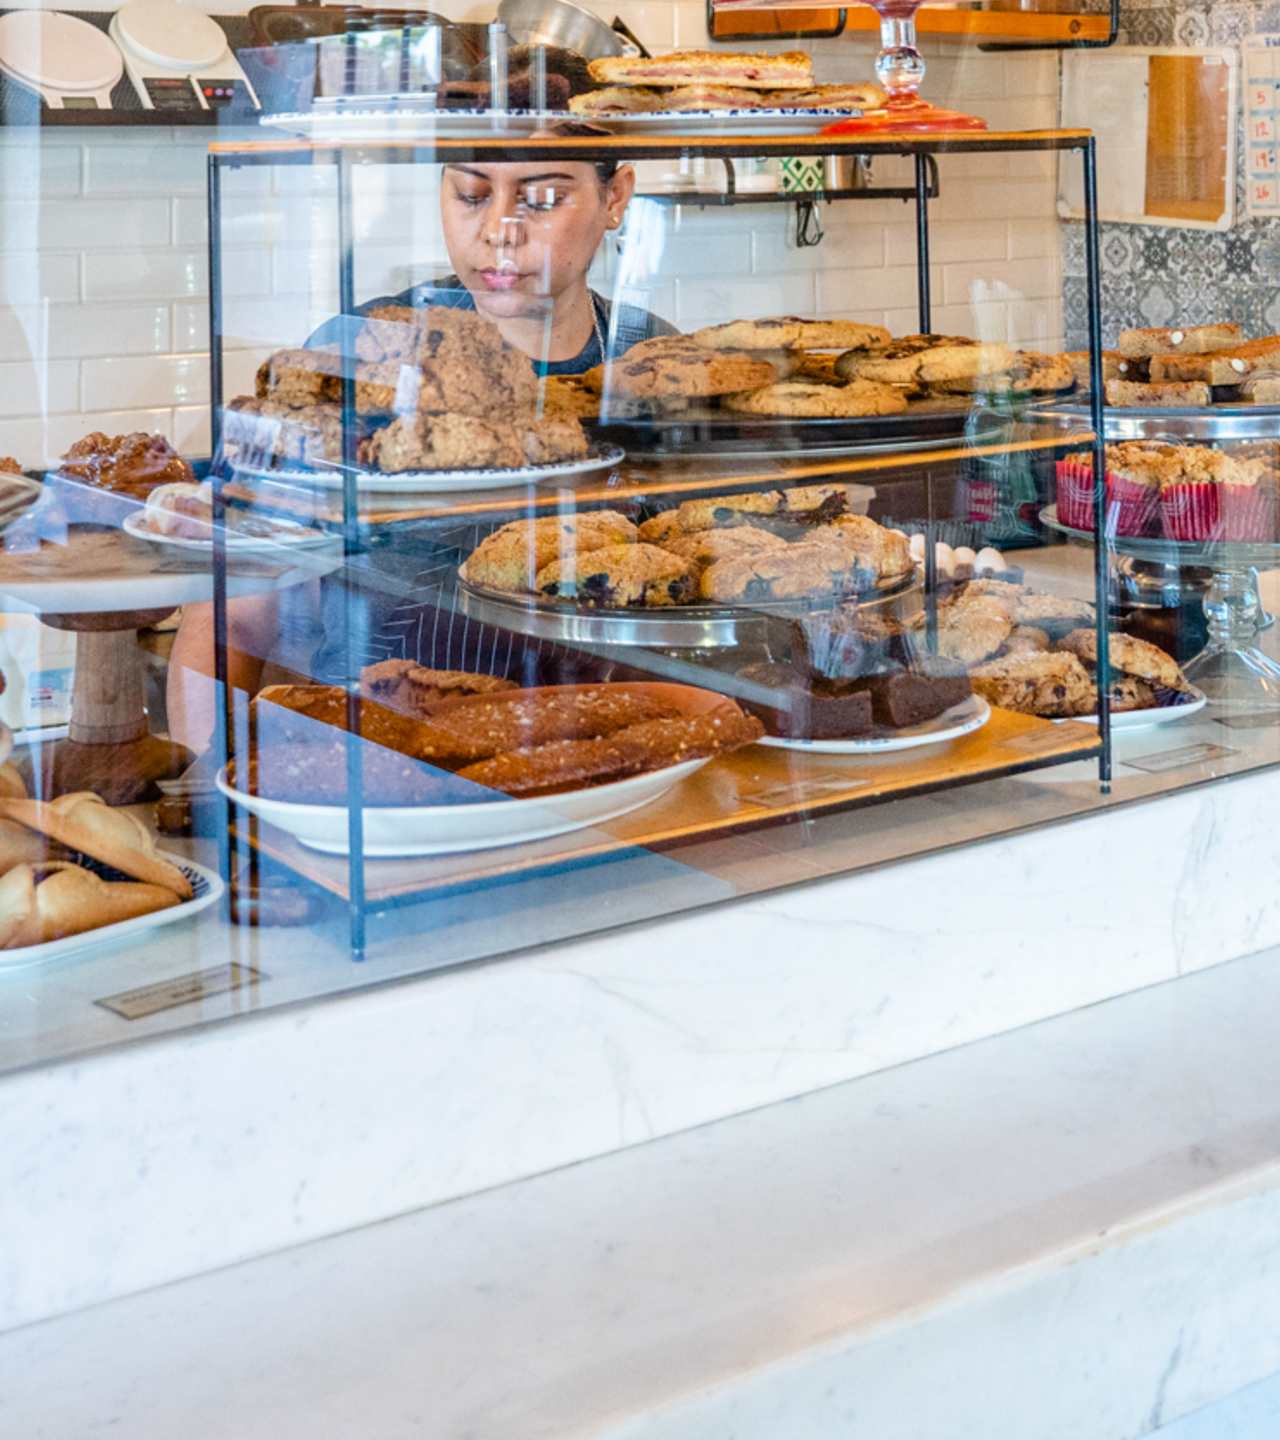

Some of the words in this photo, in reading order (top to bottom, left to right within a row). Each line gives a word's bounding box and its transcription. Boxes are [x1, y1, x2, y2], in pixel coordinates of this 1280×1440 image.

[1257, 91, 1265, 105] 5
[1255, 121, 1269, 137] 12
[1255, 151, 1268, 168] 19
[1255, 185, 1270, 201] 26
